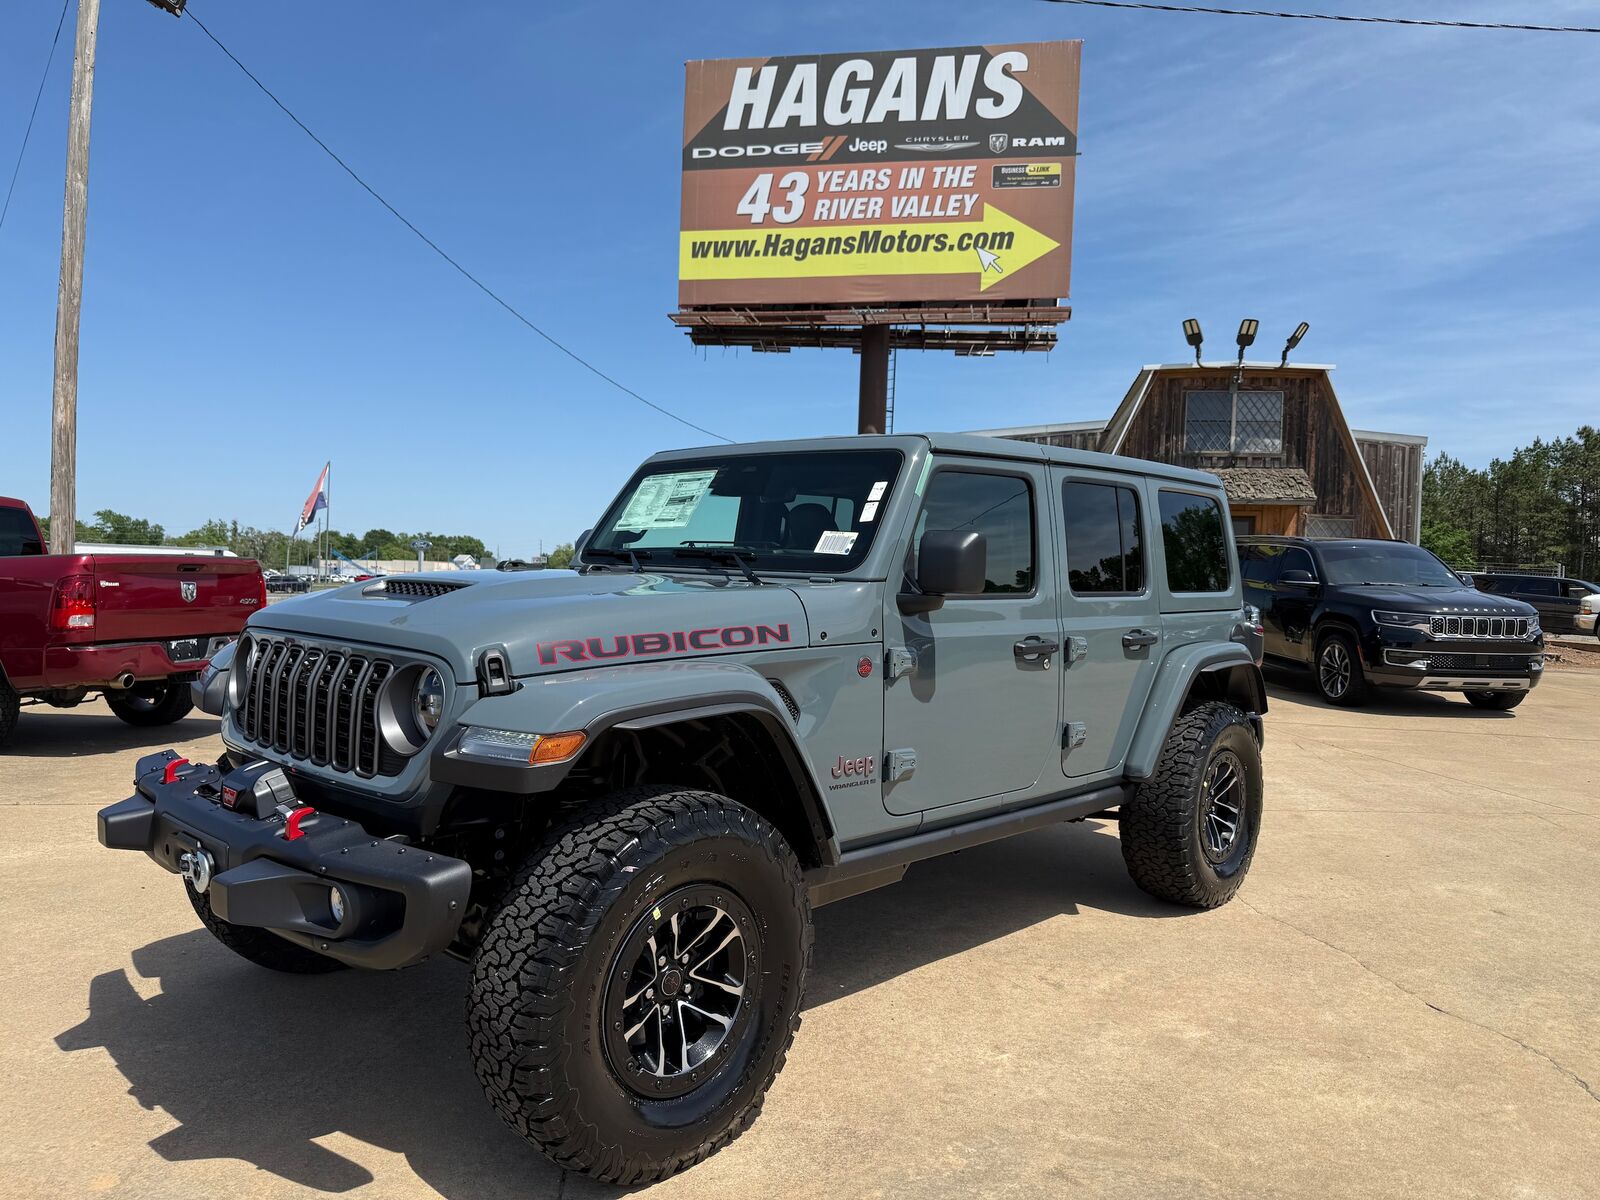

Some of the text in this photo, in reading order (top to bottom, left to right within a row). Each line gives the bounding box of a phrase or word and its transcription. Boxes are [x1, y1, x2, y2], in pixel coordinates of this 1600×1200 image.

[723, 51, 1029, 131] HAGANS
[692, 142, 824, 159] DODGE
[848, 137, 888, 154] Jeep
[905, 135, 969, 143] CHRYSLER
[1012, 136, 1066, 147] RAM
[817, 165, 977, 193] YEARS IN THE
[736, 171, 810, 224] 43
[813, 193, 980, 221] RIVER VALLEY
[691, 230, 1015, 261] www.HagansMotors.com
[537, 624, 791, 665] RUBICON
[831, 756, 874, 779] Jeep
[829, 779, 869, 791] WRANGLER
